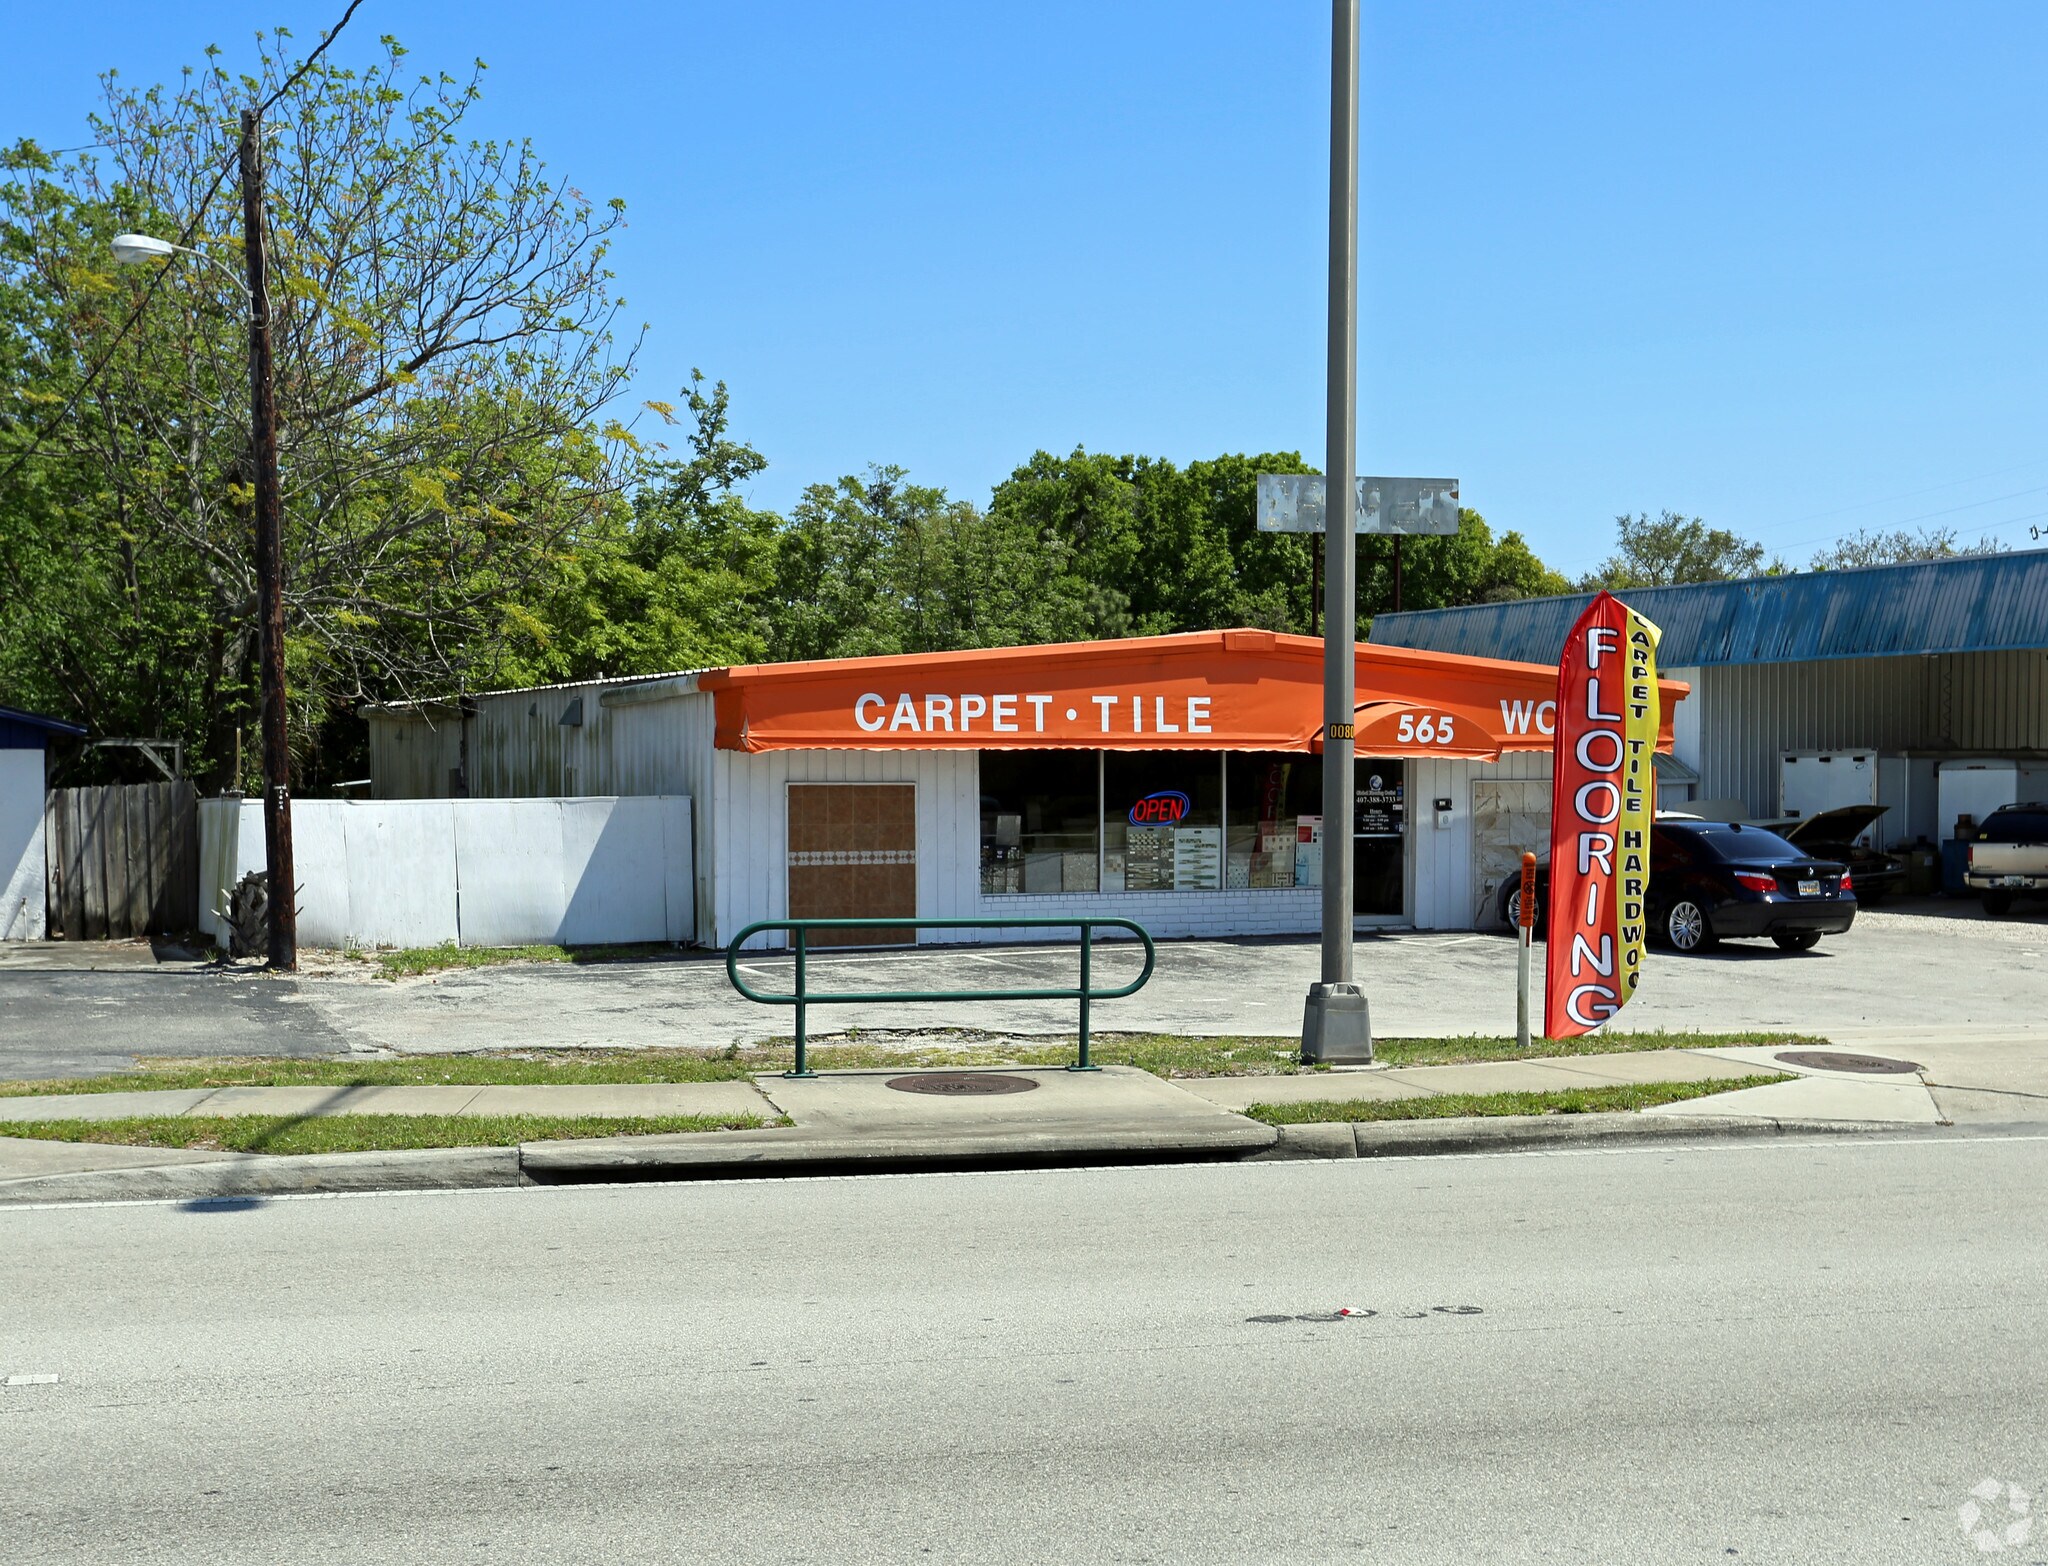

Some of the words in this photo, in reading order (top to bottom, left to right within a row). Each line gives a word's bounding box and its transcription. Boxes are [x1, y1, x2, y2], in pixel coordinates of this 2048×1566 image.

[854, 692, 1053, 733] CARPET
[1091, 695, 1212, 733] TILE
[1396, 714, 1455, 744] 565
[1625, 740, 1645, 811] TILE
[1133, 798, 1184, 822] OPEN
[1565, 626, 1624, 1027] FLOORING
